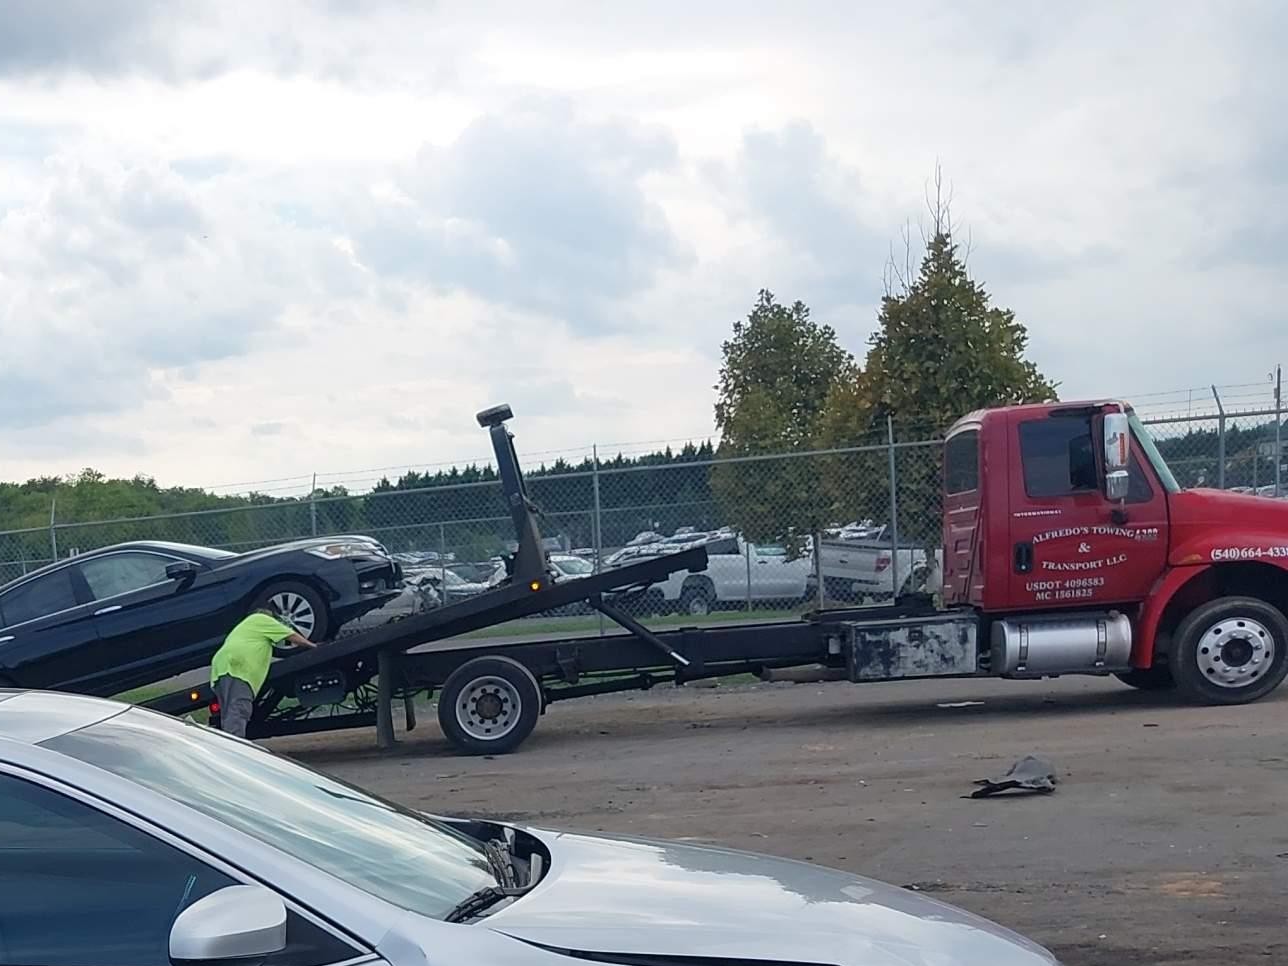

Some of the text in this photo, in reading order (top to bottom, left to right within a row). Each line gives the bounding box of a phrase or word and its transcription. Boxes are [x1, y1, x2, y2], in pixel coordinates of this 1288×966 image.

[1032, 526, 1134, 545] ALFREDO'S TOWING
[1078, 543, 1091, 553] &
[1211, 547, 1288, 561] (540)664-433
[1042, 554, 1128, 571] TRANSPORT LLC
[1025, 580, 1062, 592] USDOT
[1035, 591, 1052, 601] MC
